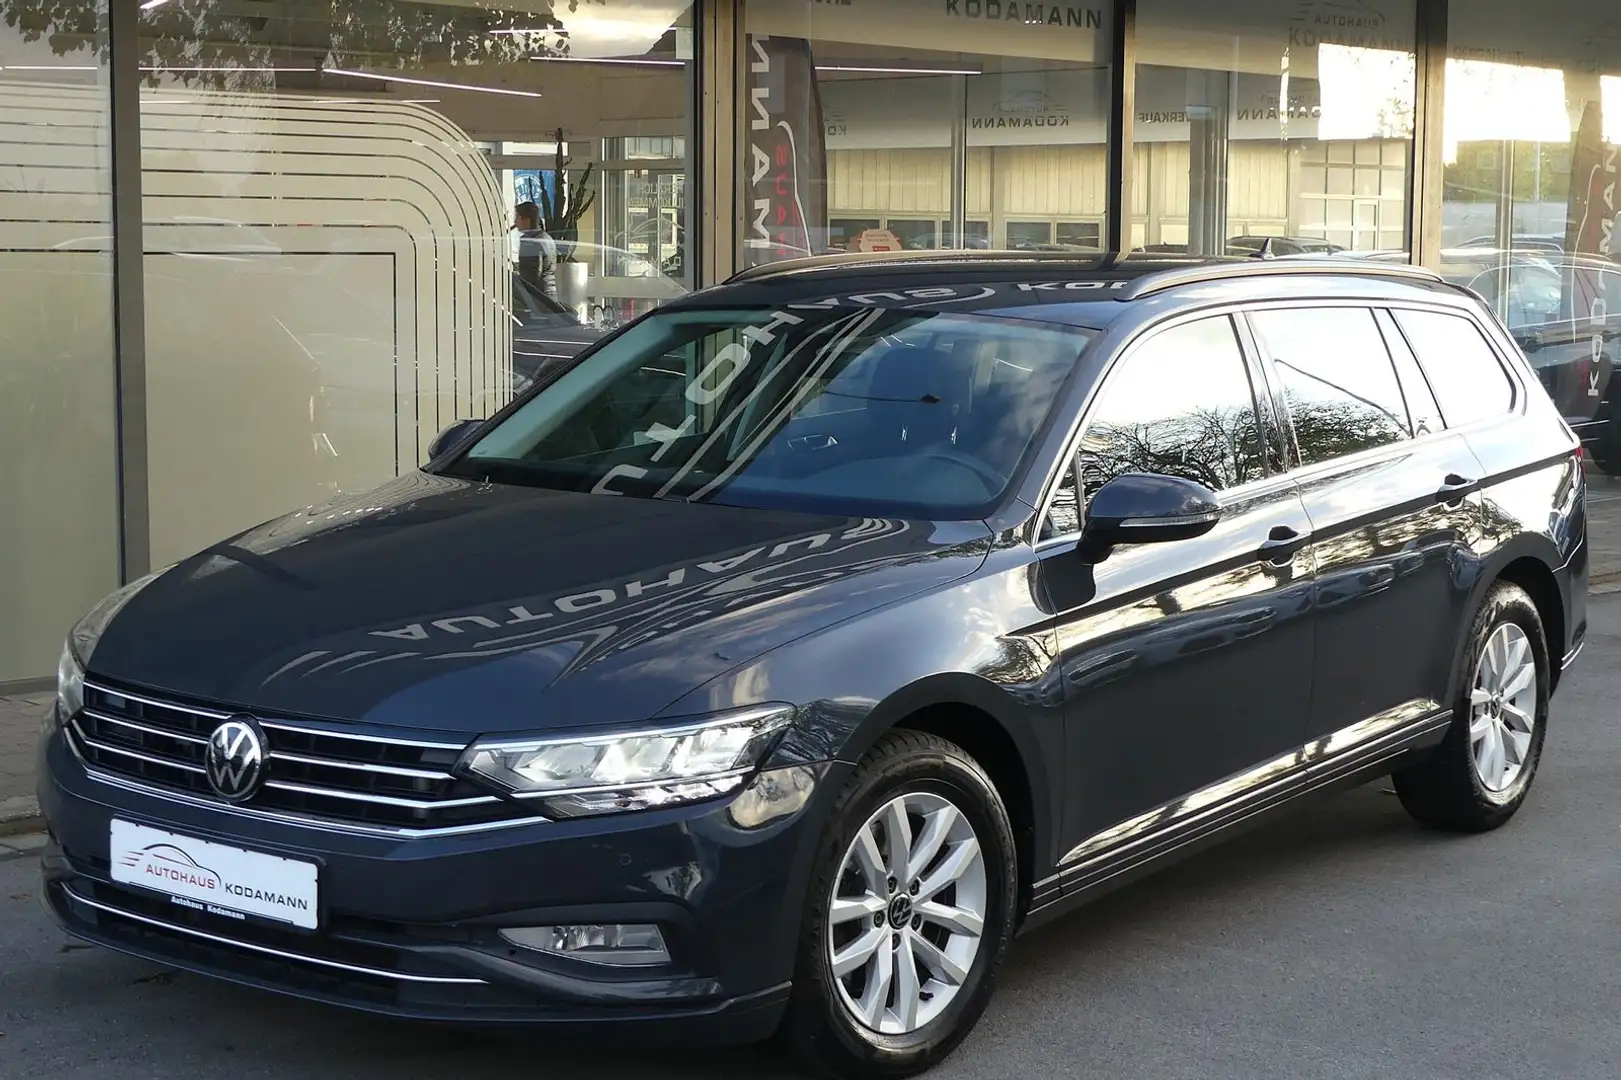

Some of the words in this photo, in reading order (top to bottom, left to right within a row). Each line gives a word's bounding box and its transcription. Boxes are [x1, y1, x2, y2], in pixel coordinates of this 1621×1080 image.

[946, 0, 1102, 29] KODAMANN
[145, 864, 216, 890] AUTOHAUS
[225, 883, 308, 911] KODAMANN
[171, 895, 204, 911] Autohaus
[207, 904, 246, 920] Kodamann
